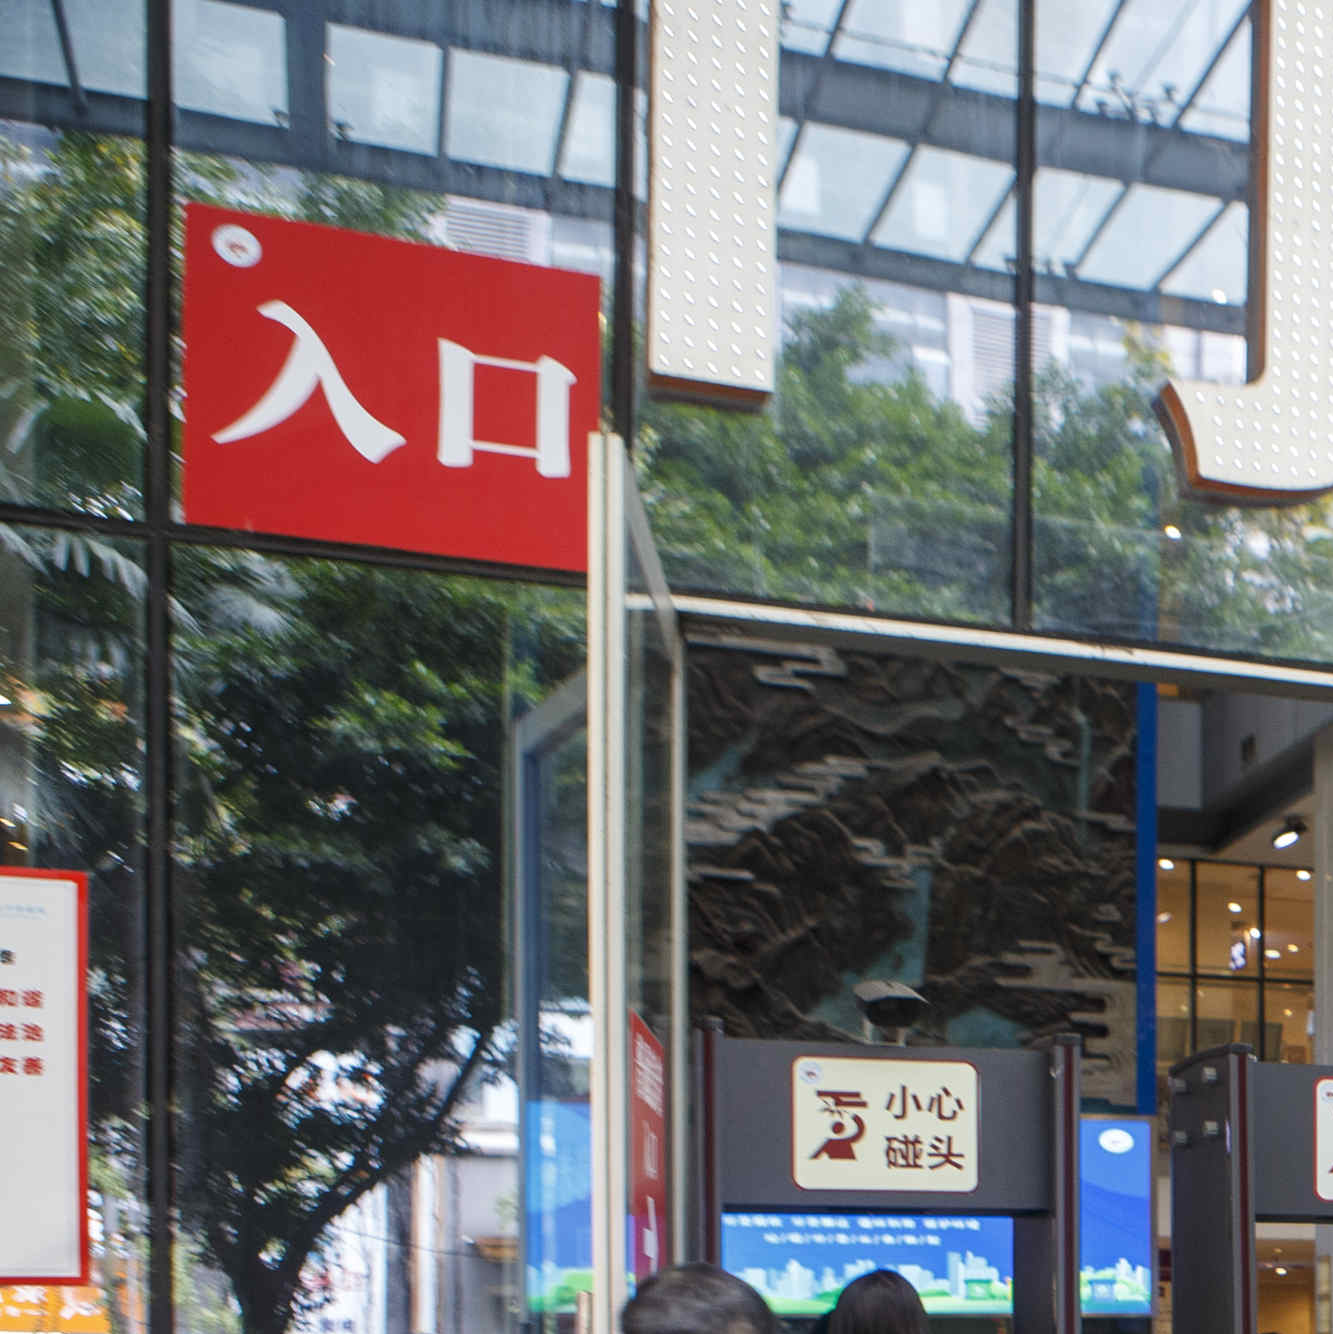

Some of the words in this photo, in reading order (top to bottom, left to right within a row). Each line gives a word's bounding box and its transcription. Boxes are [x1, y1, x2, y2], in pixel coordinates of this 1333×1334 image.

[212, 302, 577, 478] 入口
[885, 1085, 965, 1121] 小心
[885, 1135, 965, 1170] 碰头
